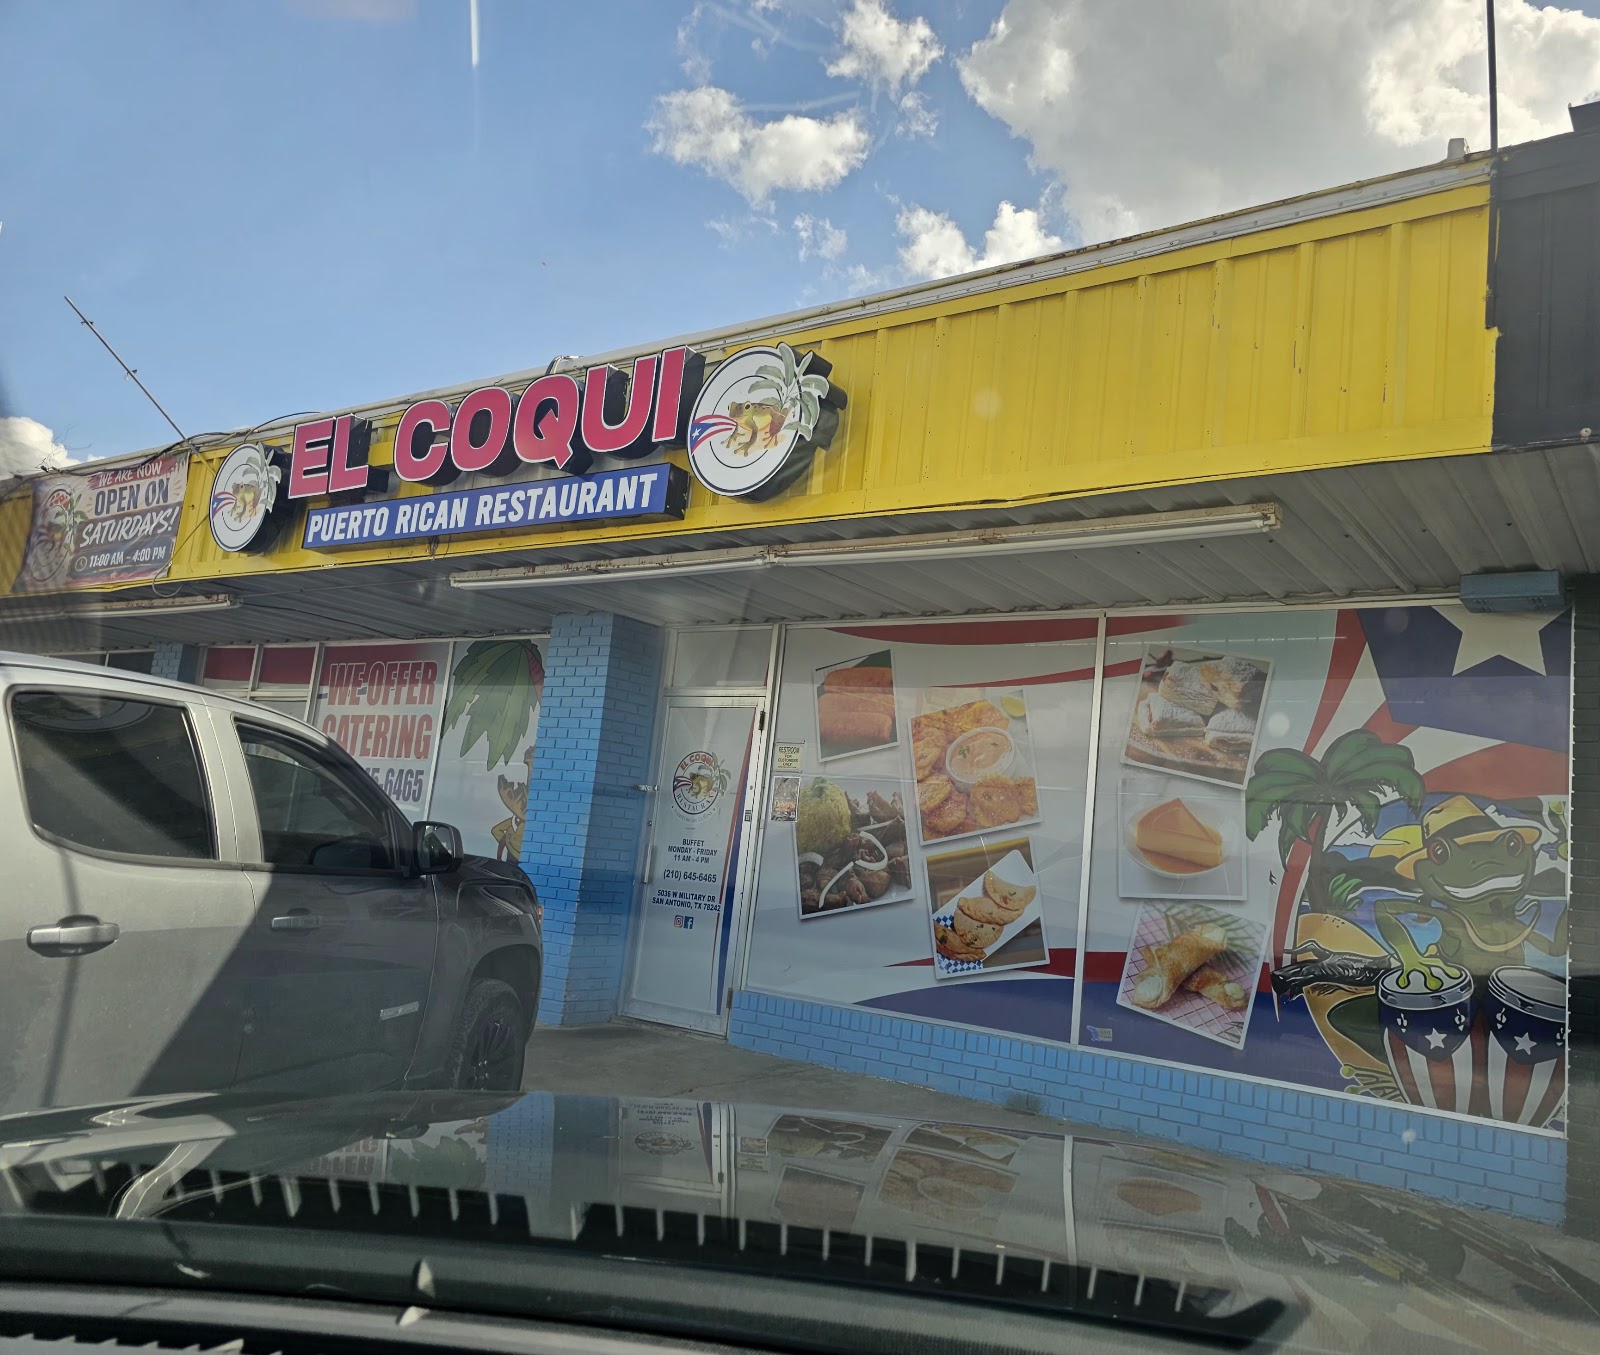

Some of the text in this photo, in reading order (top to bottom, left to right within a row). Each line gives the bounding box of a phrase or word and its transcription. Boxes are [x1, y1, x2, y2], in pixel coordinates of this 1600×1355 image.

[288, 345, 687, 499] EL COQUI
[99, 473, 113, 487] WE
[137, 461, 163, 478] NOW
[95, 483, 140, 516] OPEN
[145, 478, 170, 507] ON
[307, 473, 658, 543] PUERTO RICAN RESTAURANT
[80, 506, 180, 548] SATURDAYS!
[89, 554, 110, 568] 11:00
[110, 551, 124, 565] AM
[132, 548, 151, 562] 4:00
[152, 546, 166, 559] PM
[327, 661, 438, 706] WE OFFER
[322, 713, 433, 760] CATERING
[680, 761, 689, 771] EL
[668, 846, 692, 854] MONDAY
[696, 849, 718, 857] FRIDAY
[682, 838, 705, 847] BUFFET
[663, 869, 717, 883] (210) 645-6465
[652, 897, 664, 905] SAN
[664, 898, 693, 909] ANTONIO,
[703, 903, 721, 912] 78242
[679, 892, 706, 901] MILITARY
[707, 895, 716, 903] DR
